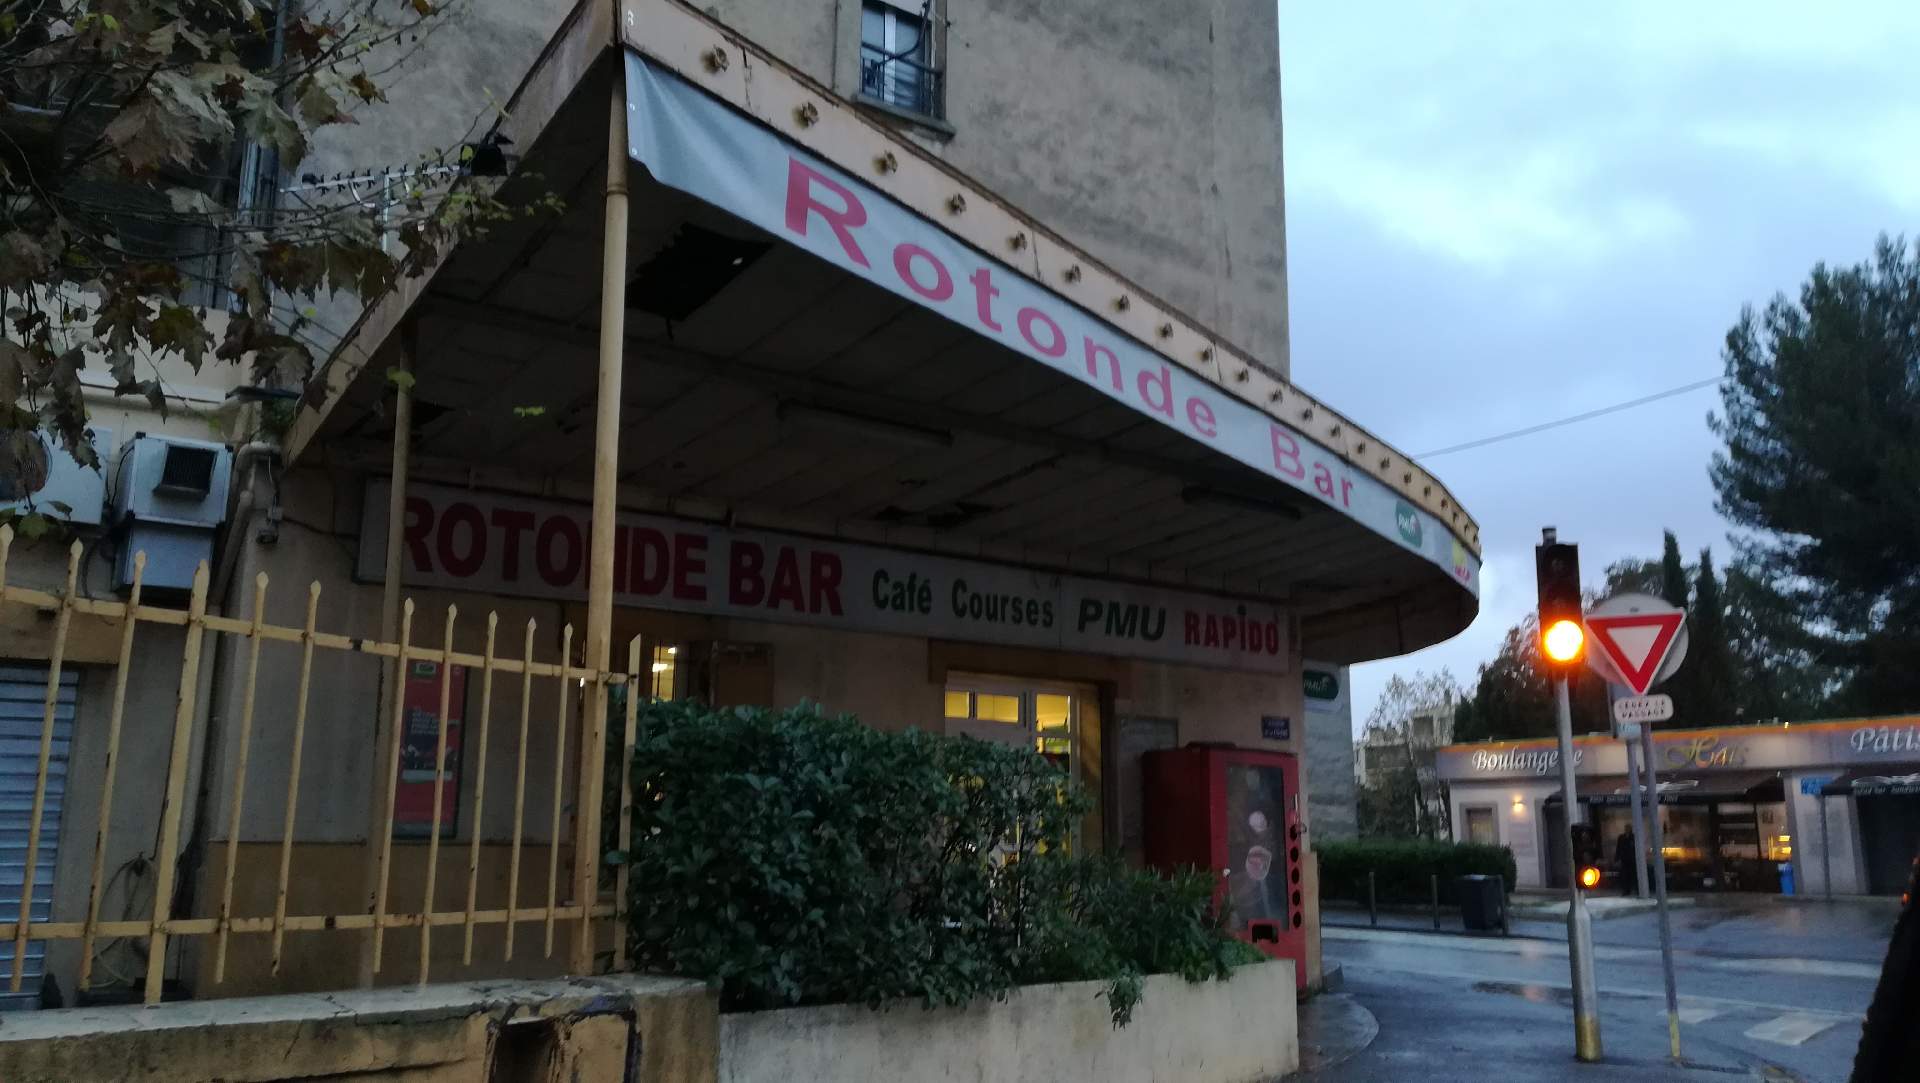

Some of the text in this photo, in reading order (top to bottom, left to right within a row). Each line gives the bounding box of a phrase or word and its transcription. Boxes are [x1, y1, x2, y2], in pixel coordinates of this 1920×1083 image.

[785, 156, 1353, 507] Rotonde Bar
[729, 539, 844, 616] BAR
[873, 568, 932, 614] Café
[952, 578, 1054, 628] Courses
[1077, 597, 1166, 641] PMU
[1472, 744, 1583, 776] Boulangee
